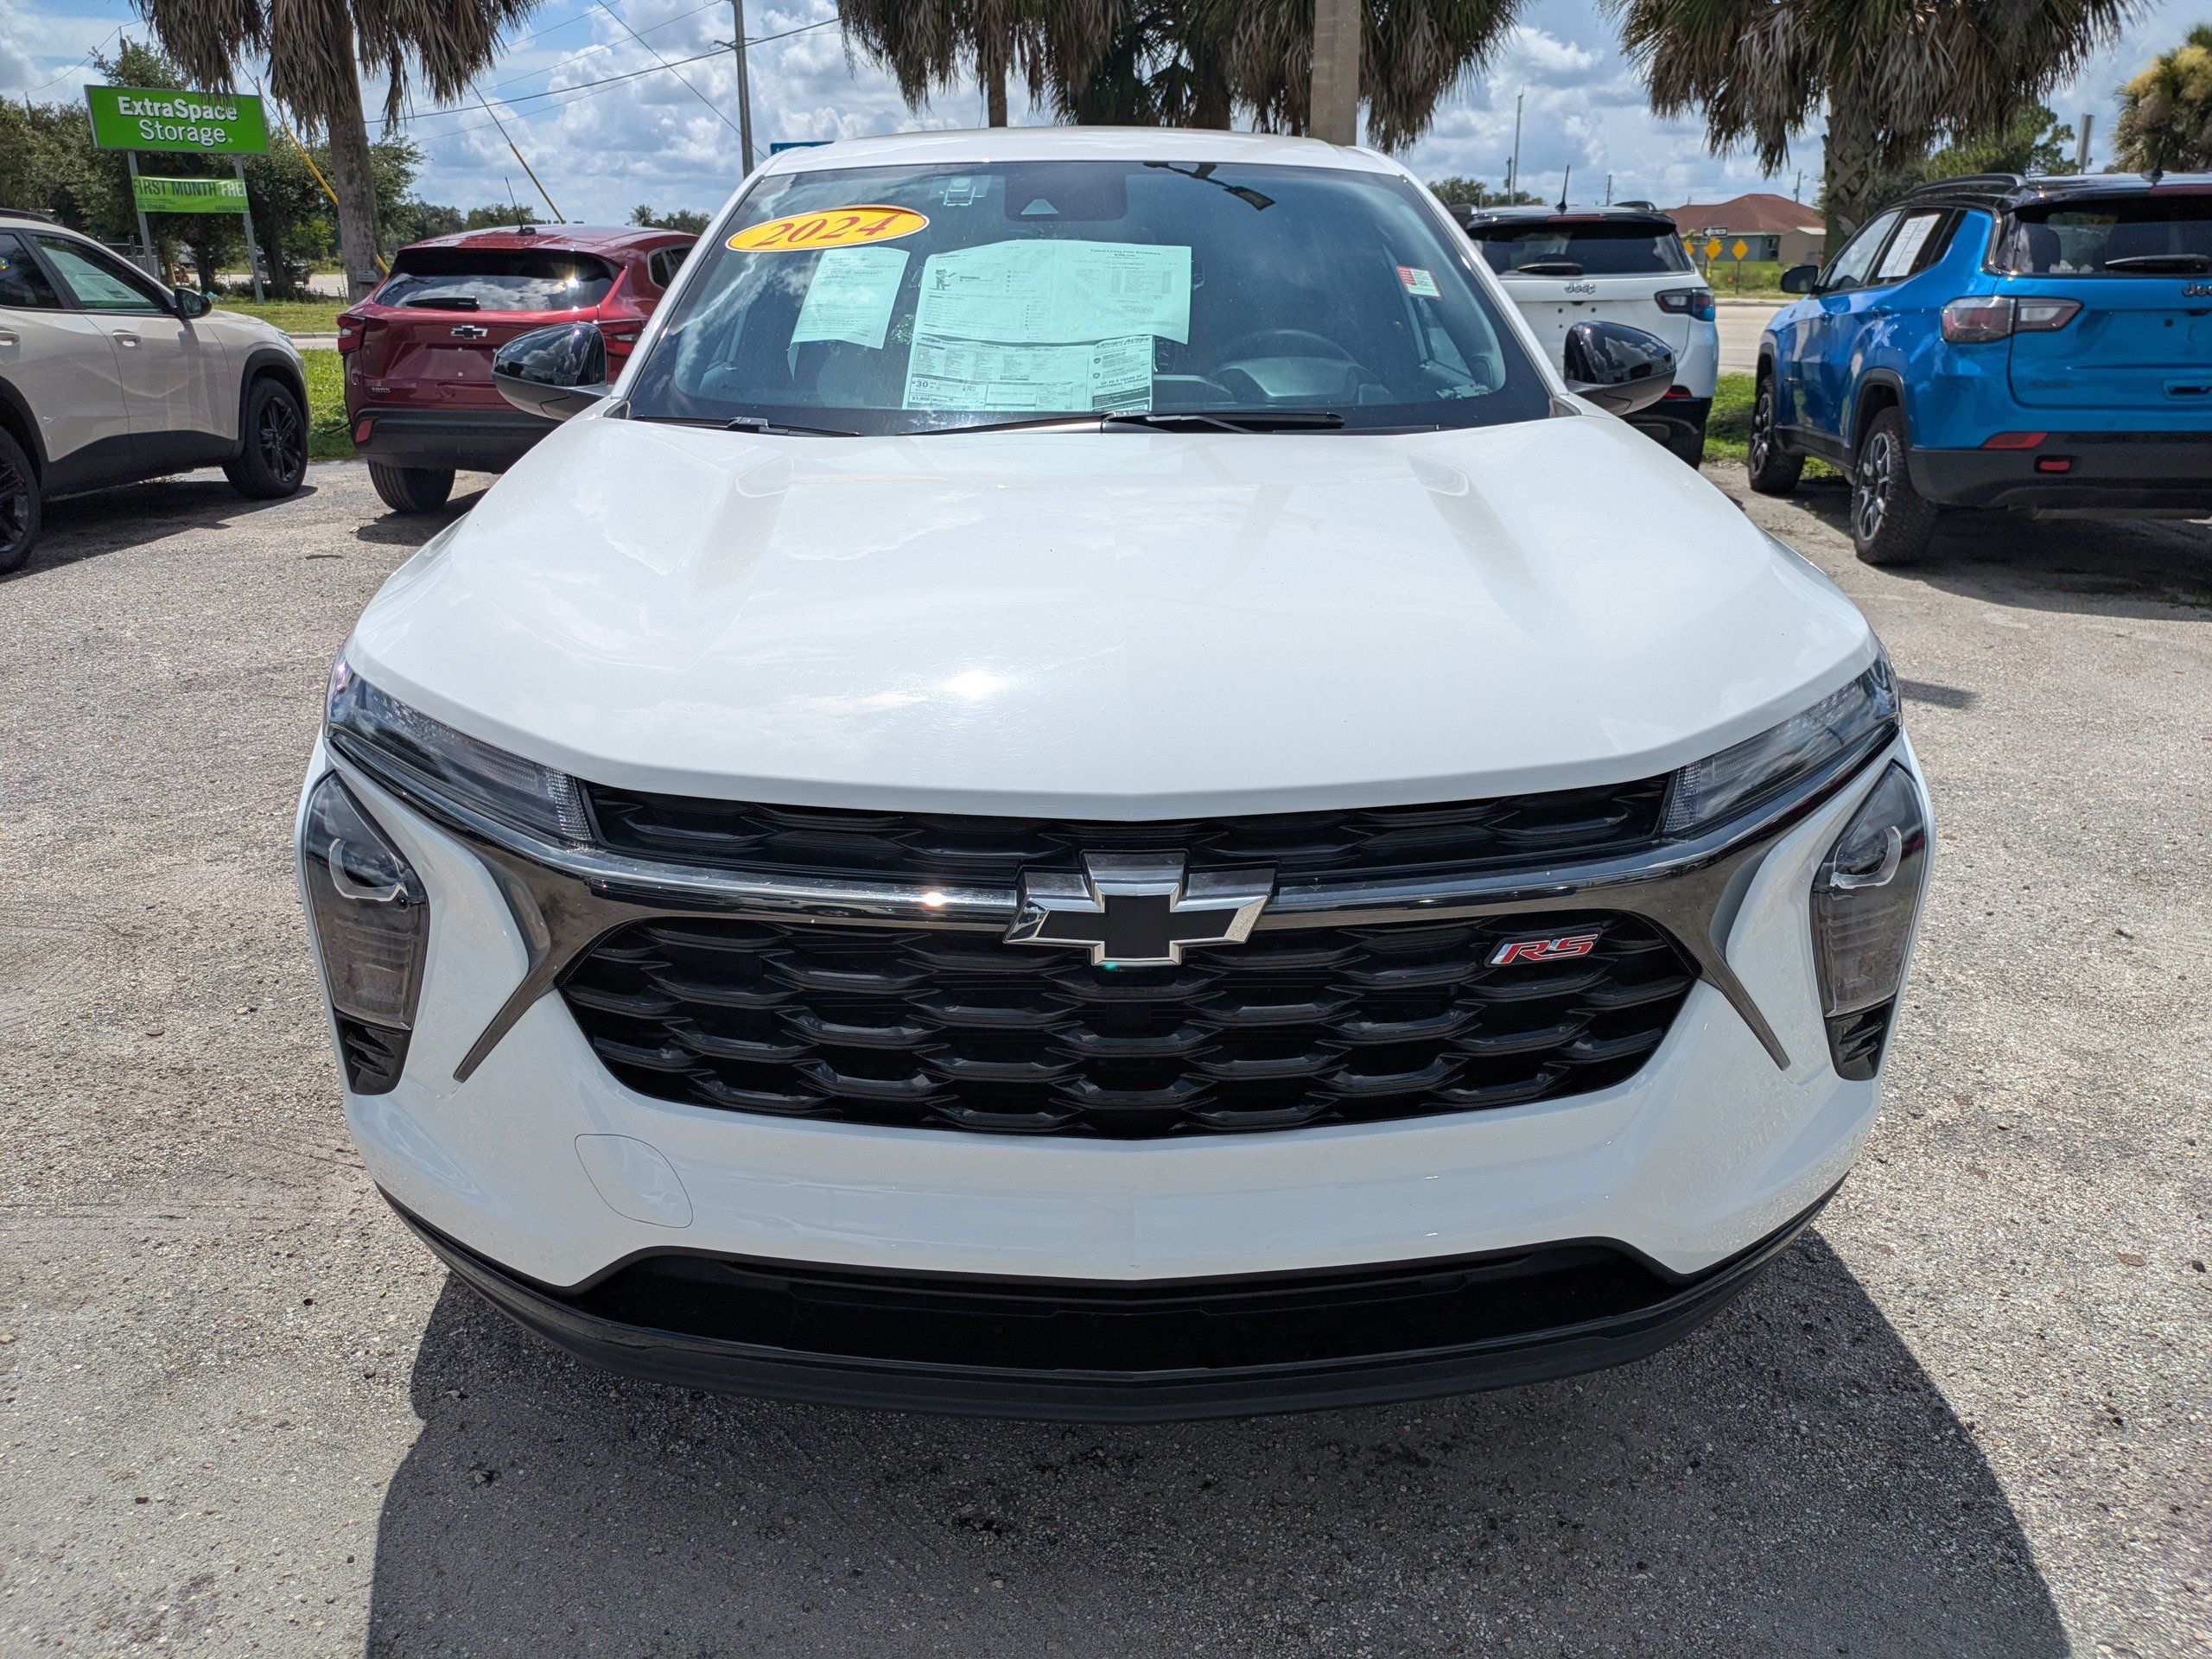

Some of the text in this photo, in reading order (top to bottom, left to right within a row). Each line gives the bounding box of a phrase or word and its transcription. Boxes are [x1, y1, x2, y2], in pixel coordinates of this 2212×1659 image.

[118, 96, 238, 123] ExtraSpace
[170, 181, 217, 196] MONTH
[750, 213, 900, 248] 2024
[1564, 283, 1596, 295] Jeep
[1491, 934, 1598, 964] RS
